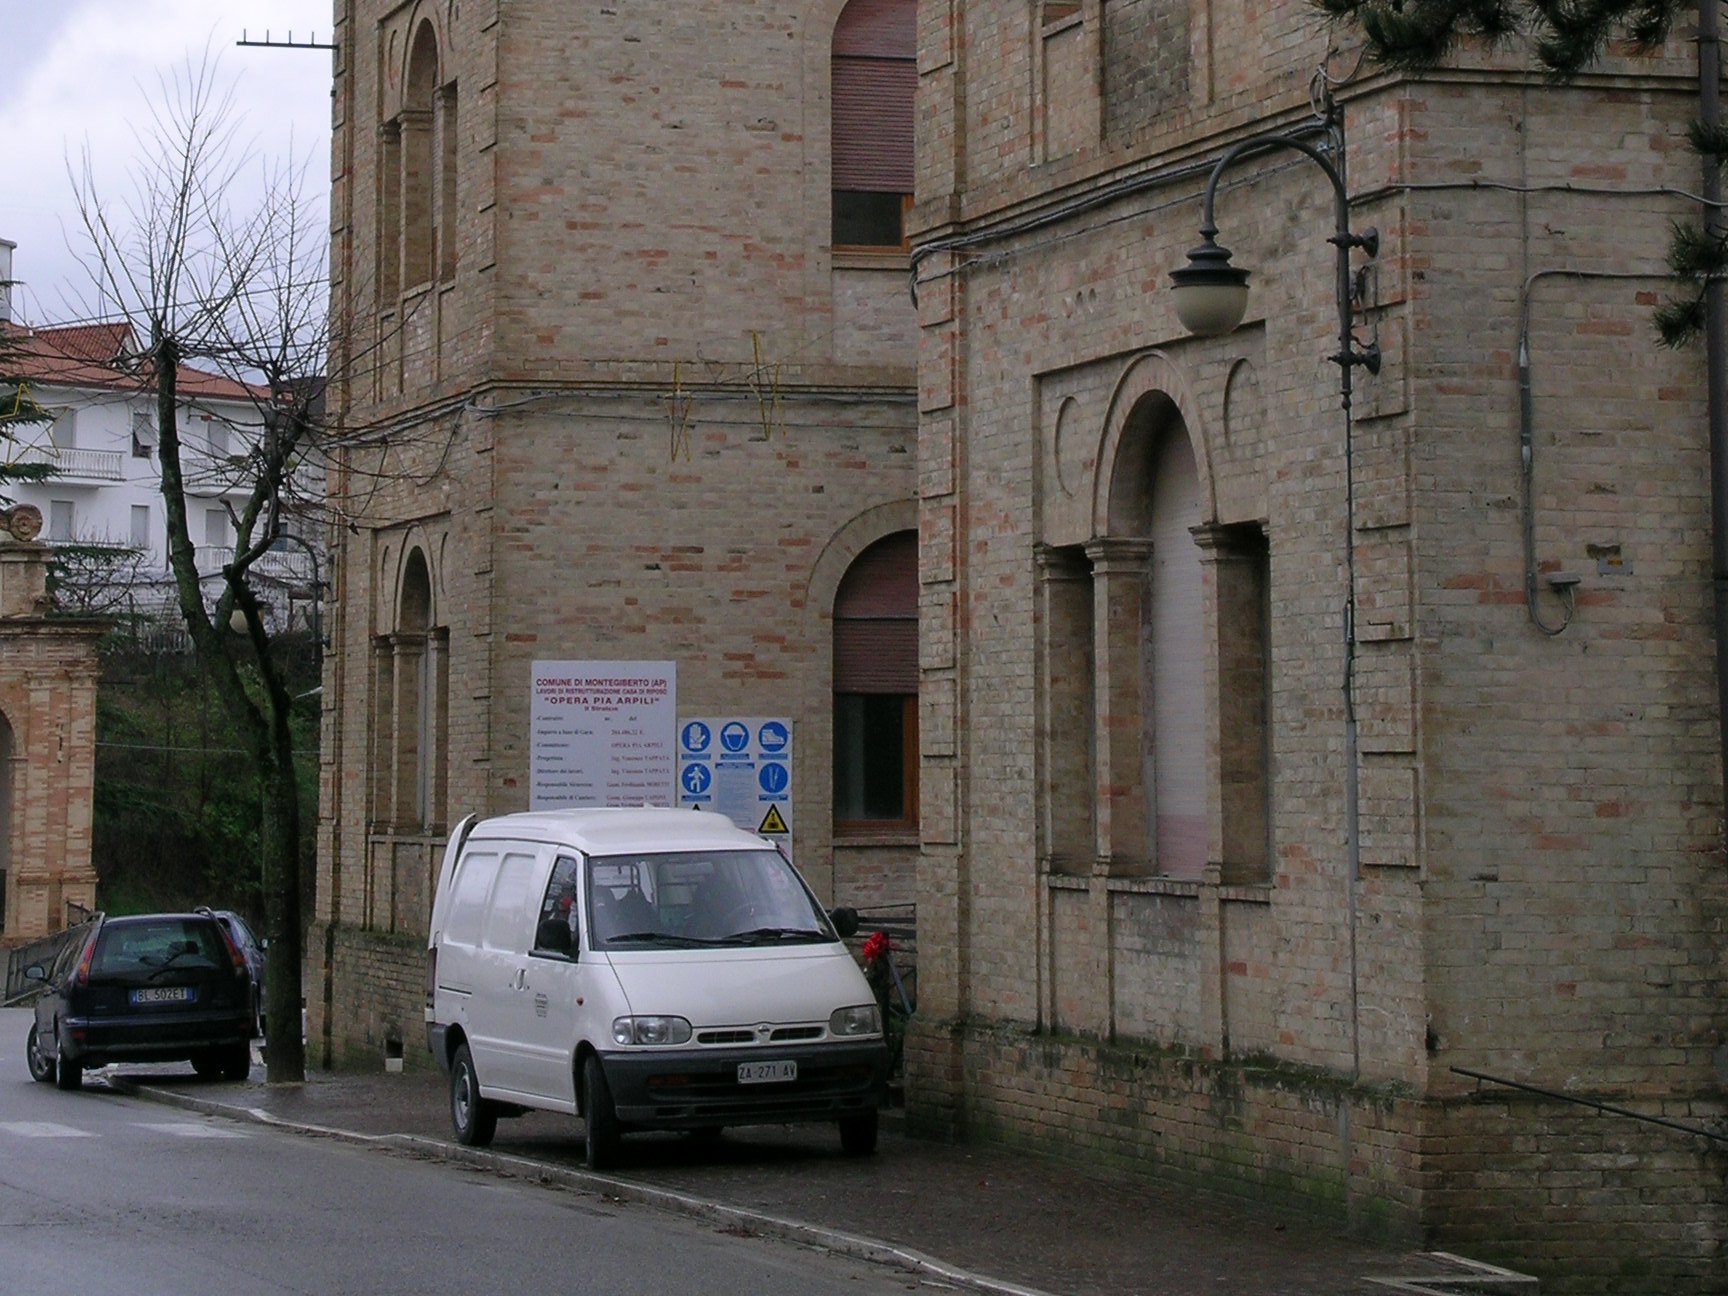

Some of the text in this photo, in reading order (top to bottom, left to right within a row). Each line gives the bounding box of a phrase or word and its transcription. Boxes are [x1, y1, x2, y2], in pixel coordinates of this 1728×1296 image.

[536, 678, 667, 688] COMUNE DI MONTEGIBERTO (AP)
[544, 697, 660, 705] "OPERA PIA ARPILI"
[138, 990, 150, 1001] BL
[739, 1065, 796, 1079] ZA-271 AV
